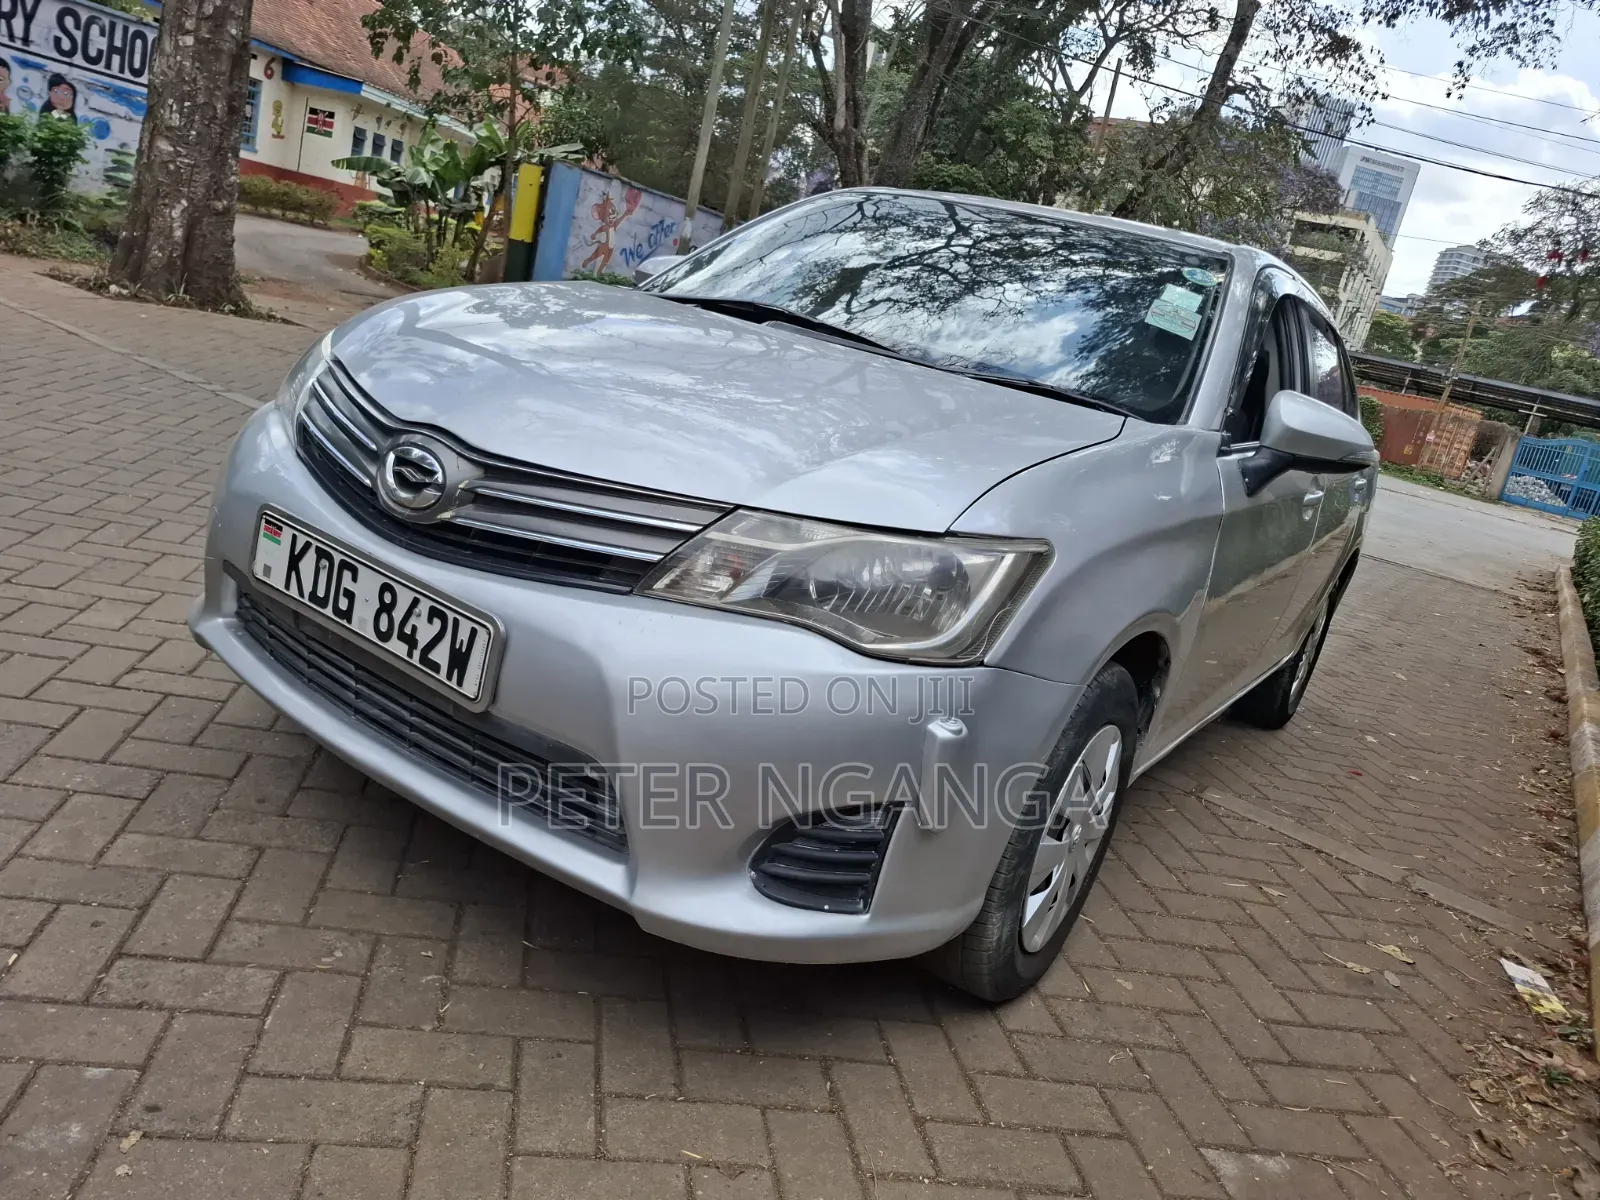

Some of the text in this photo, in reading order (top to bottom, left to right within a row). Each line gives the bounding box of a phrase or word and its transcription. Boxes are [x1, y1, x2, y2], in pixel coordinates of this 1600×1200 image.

[53, 6, 157, 78] SCHO
[263, 57, 276, 80] 6
[620, 232, 644, 268] We
[284, 533, 360, 625] KDG
[373, 581, 478, 688] 842W
